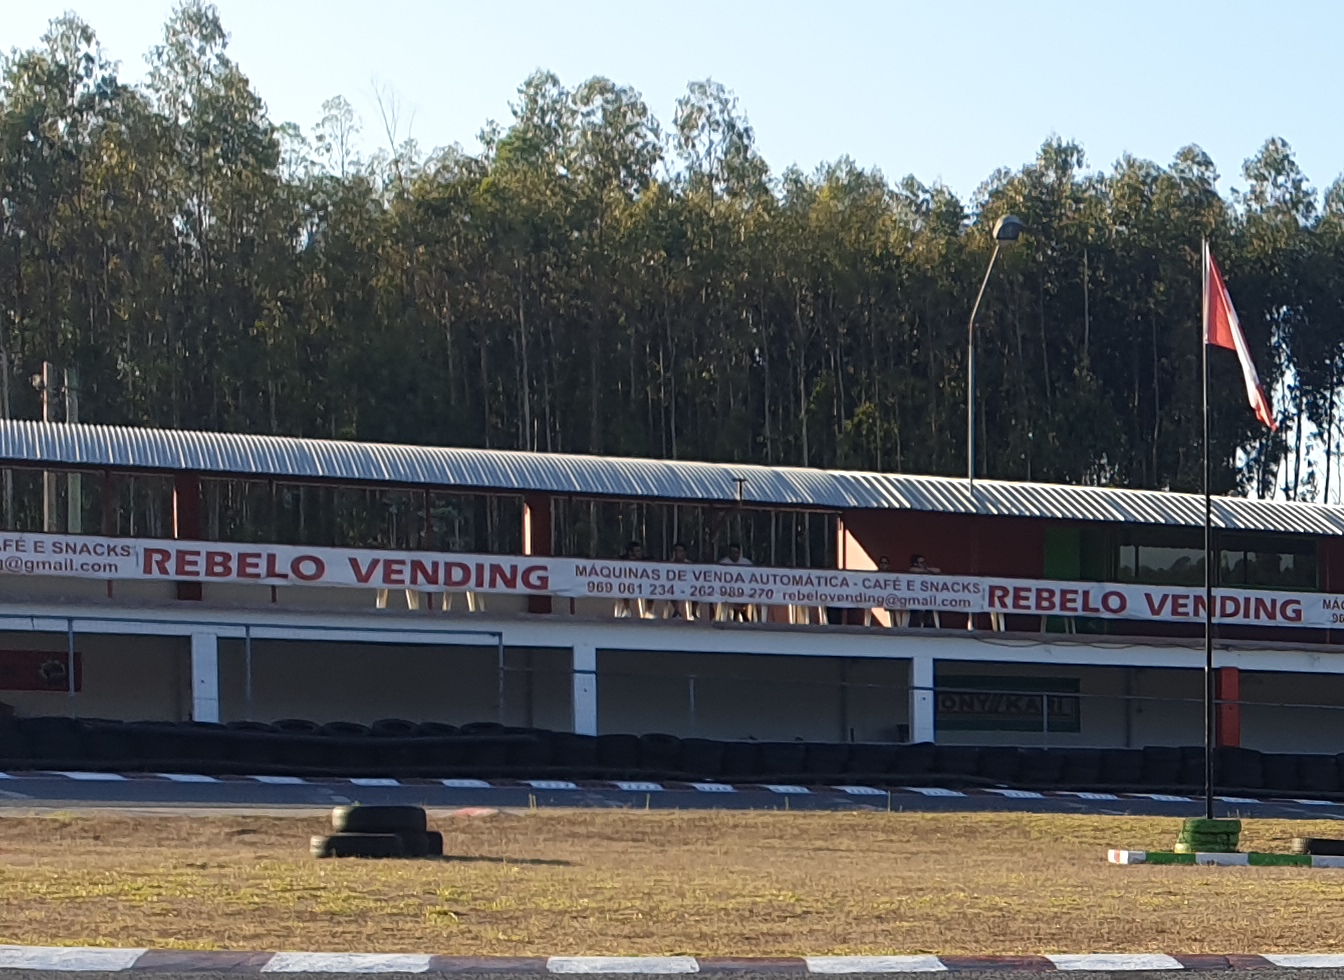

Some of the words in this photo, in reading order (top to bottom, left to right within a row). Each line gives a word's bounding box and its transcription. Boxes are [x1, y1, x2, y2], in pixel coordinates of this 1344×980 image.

[0, 537, 27, 553] FÉ
[34, 541, 45, 554] E
[52, 541, 131, 557] SNACKS
[143, 547, 326, 581] REBELO
[348, 557, 549, 591] VENDING
[575, 563, 661, 581] MÁQUINAS
[666, 570, 687, 582] DE
[692, 571, 745, 584] VENDA
[750, 572, 850, 588] AUTOMÁTICA
[862, 577, 902, 591] CAFÉ
[907, 580, 915, 592] E
[920, 581, 981, 594] SNACKS
[618, 583, 643, 595] 061
[650, 584, 675, 596] 234
[690, 585, 714, 597] 262
[750, 587, 774, 599] 270
[988, 585, 1127, 614] REBELO
[1144, 593, 1303, 622] VENDING
